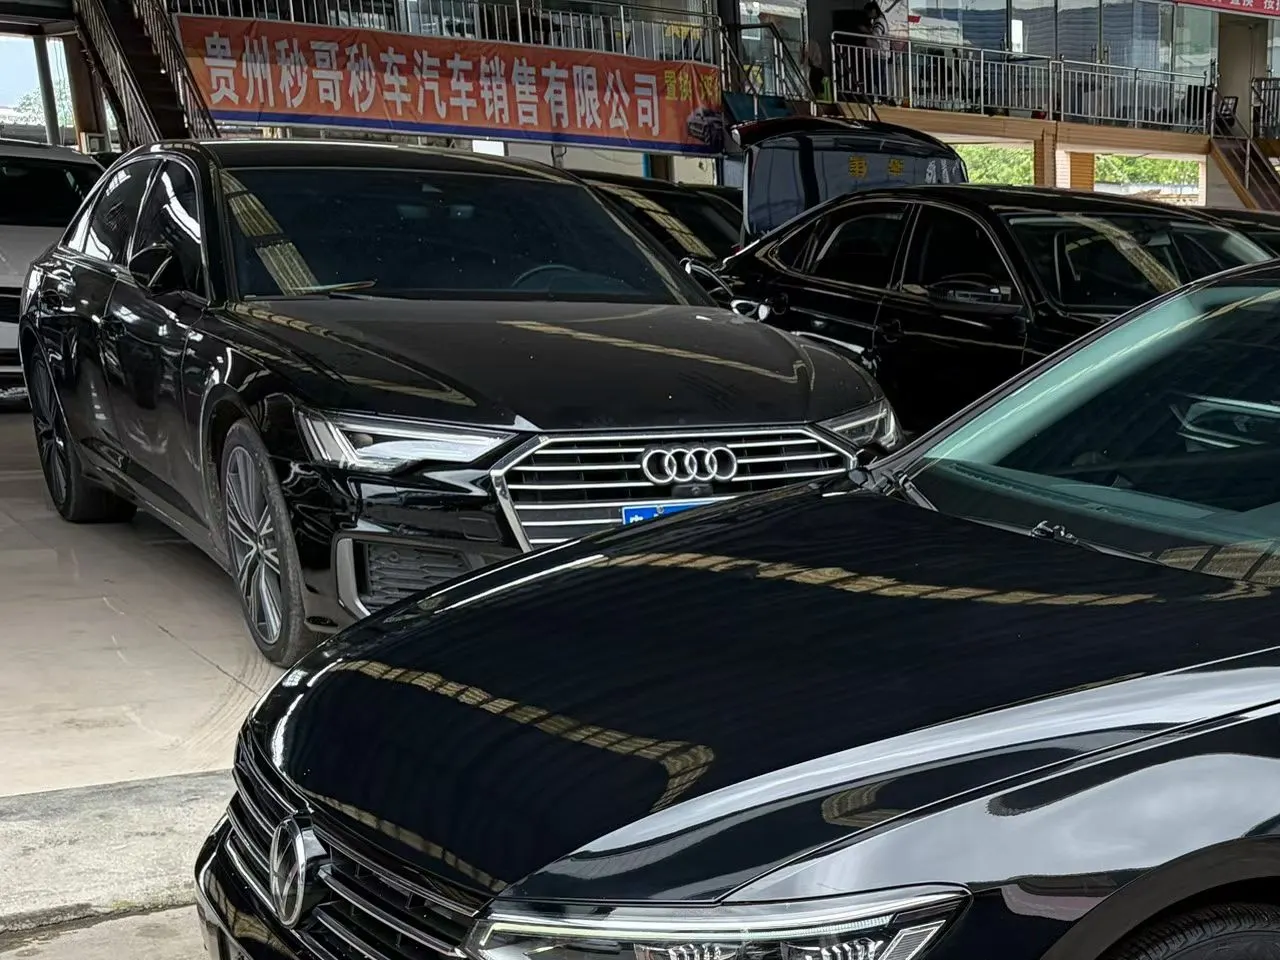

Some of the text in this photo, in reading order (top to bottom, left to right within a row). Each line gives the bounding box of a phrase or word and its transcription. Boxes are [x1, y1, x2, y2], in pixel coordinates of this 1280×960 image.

[203, 31, 659, 137] 贵州秒哥秒车汽车销售有限公司
